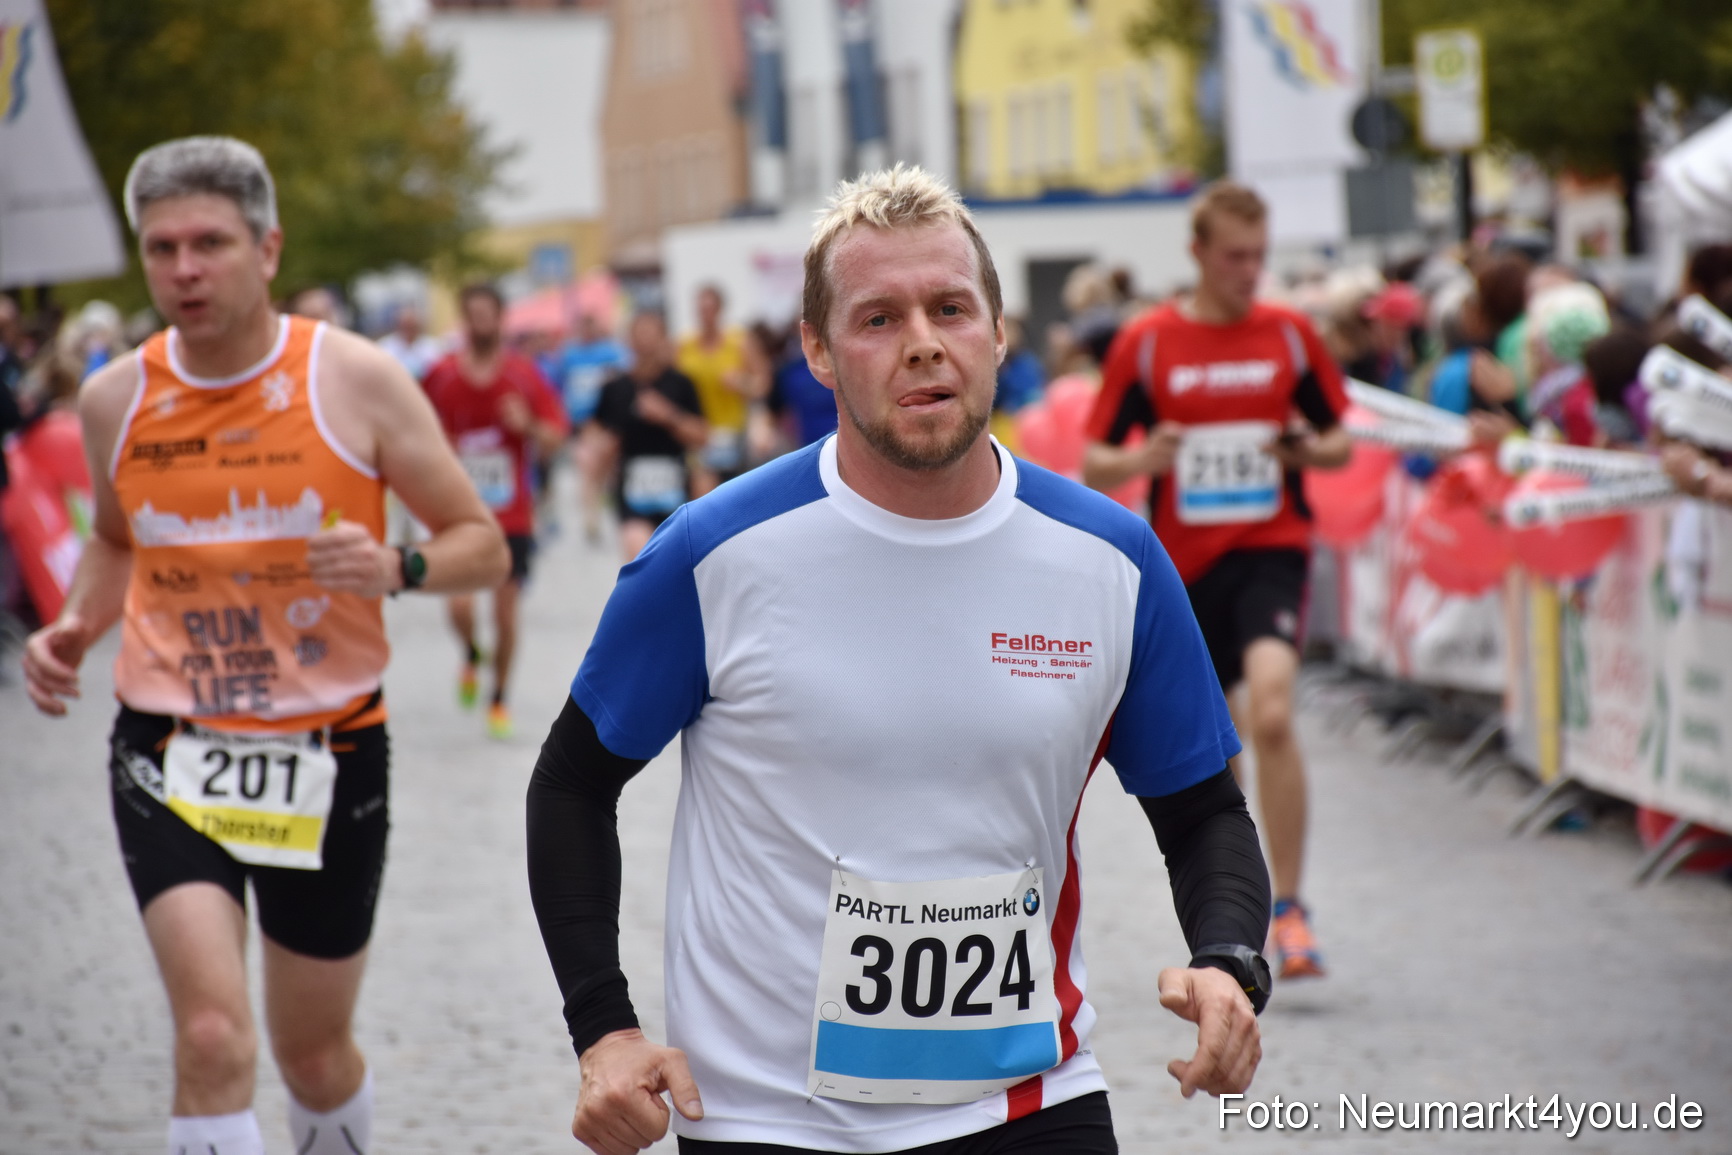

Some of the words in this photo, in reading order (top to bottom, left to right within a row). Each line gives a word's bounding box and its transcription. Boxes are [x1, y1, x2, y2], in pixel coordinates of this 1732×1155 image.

[183, 605, 264, 648] RUN
[991, 632, 1093, 653] Felßner
[182, 653, 214, 673] FOR
[221, 649, 278, 671] YOUR
[992, 655, 1038, 668] Heizung
[1050, 658, 1093, 668] Sanitär
[1010, 669, 1076, 680] Flaschnerei
[202, 749, 299, 805] 201
[201, 812, 291, 844] Thorsten
[835, 893, 914, 924] PARTL
[921, 898, 1018, 924] Neumarkt
[845, 929, 1035, 1018] 3024
